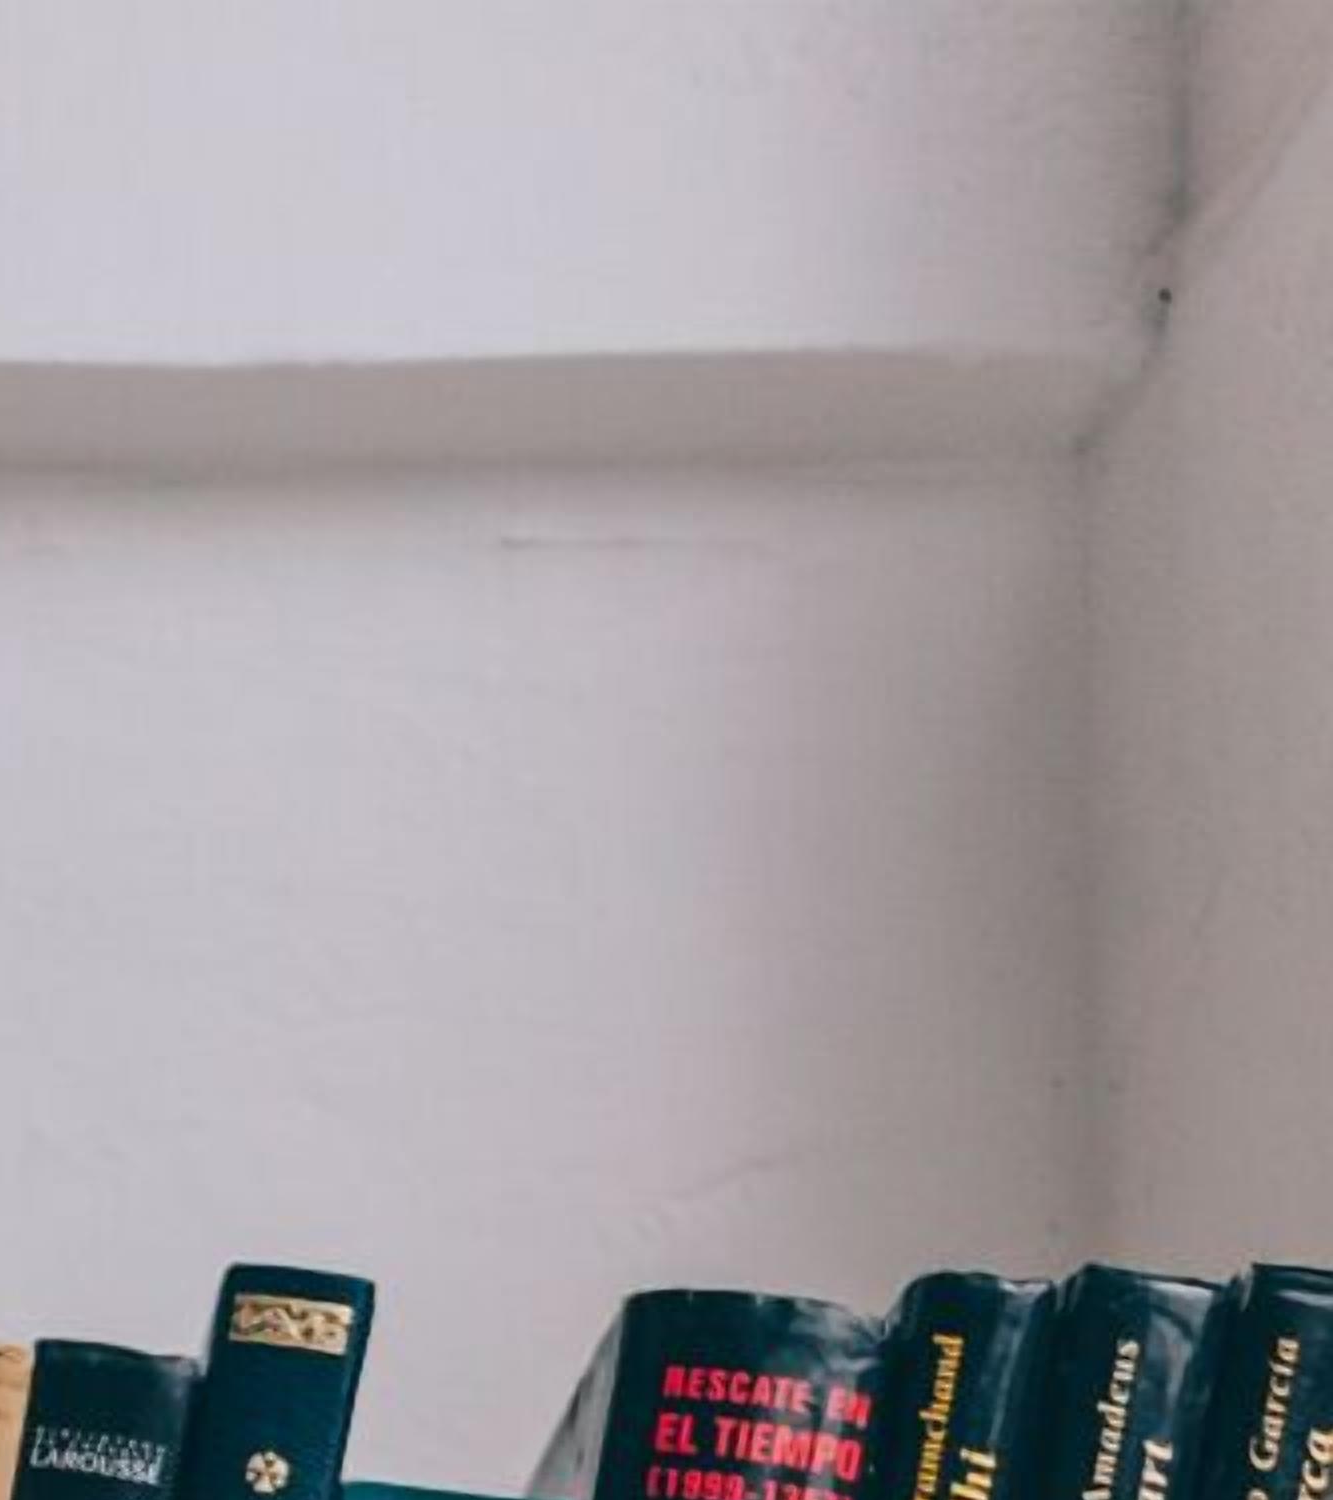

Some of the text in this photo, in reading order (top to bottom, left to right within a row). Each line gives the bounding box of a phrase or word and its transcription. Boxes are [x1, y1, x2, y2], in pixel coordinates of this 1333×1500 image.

[665, 1367, 815, 1421] RESCATE
[655, 1413, 861, 1481] EL TIEMPO
